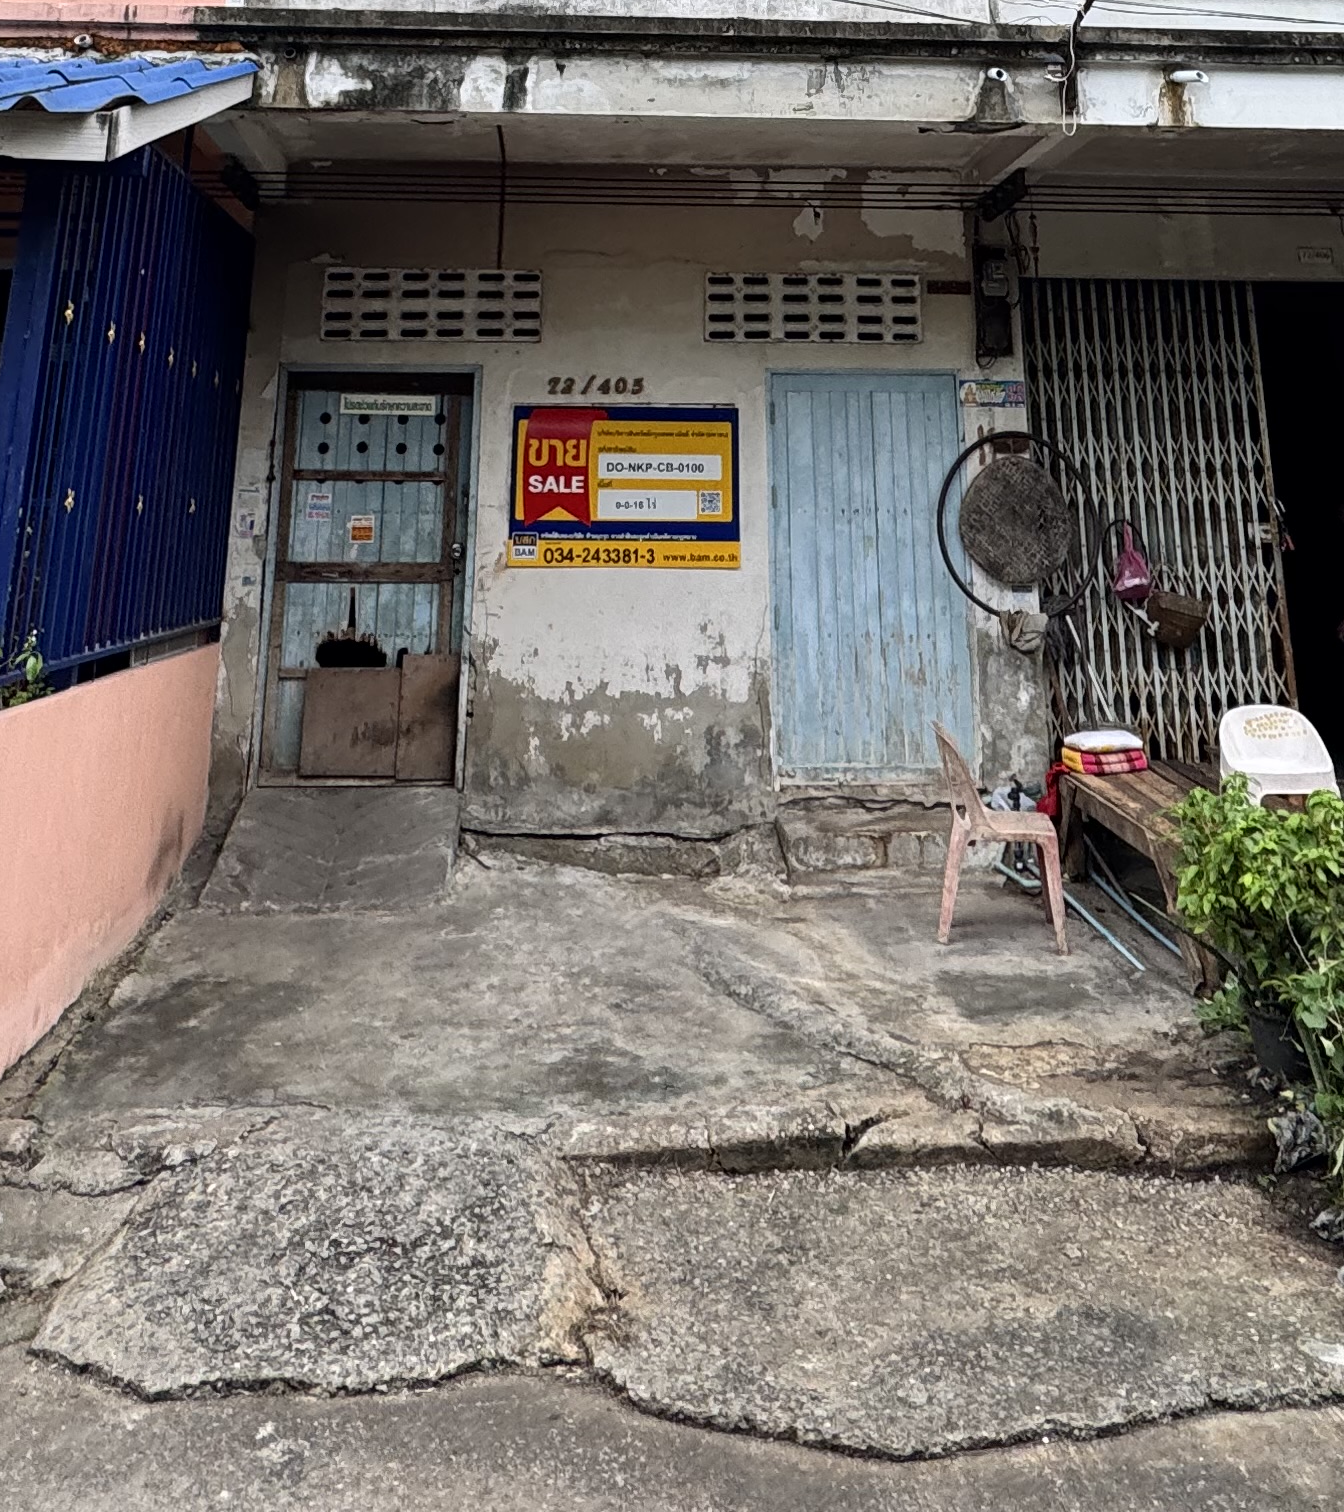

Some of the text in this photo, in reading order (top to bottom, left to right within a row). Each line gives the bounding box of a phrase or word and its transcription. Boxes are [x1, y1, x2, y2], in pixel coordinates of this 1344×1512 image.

[528, 438, 588, 467] ขาย
[606, 461, 705, 474] DO-NKP-CB-0100
[528, 474, 585, 494] SALE
[515, 548, 536, 557] BAM
[543, 547, 655, 564] 034-243381-3
[662, 552, 739, 563] www.bam.co.th
